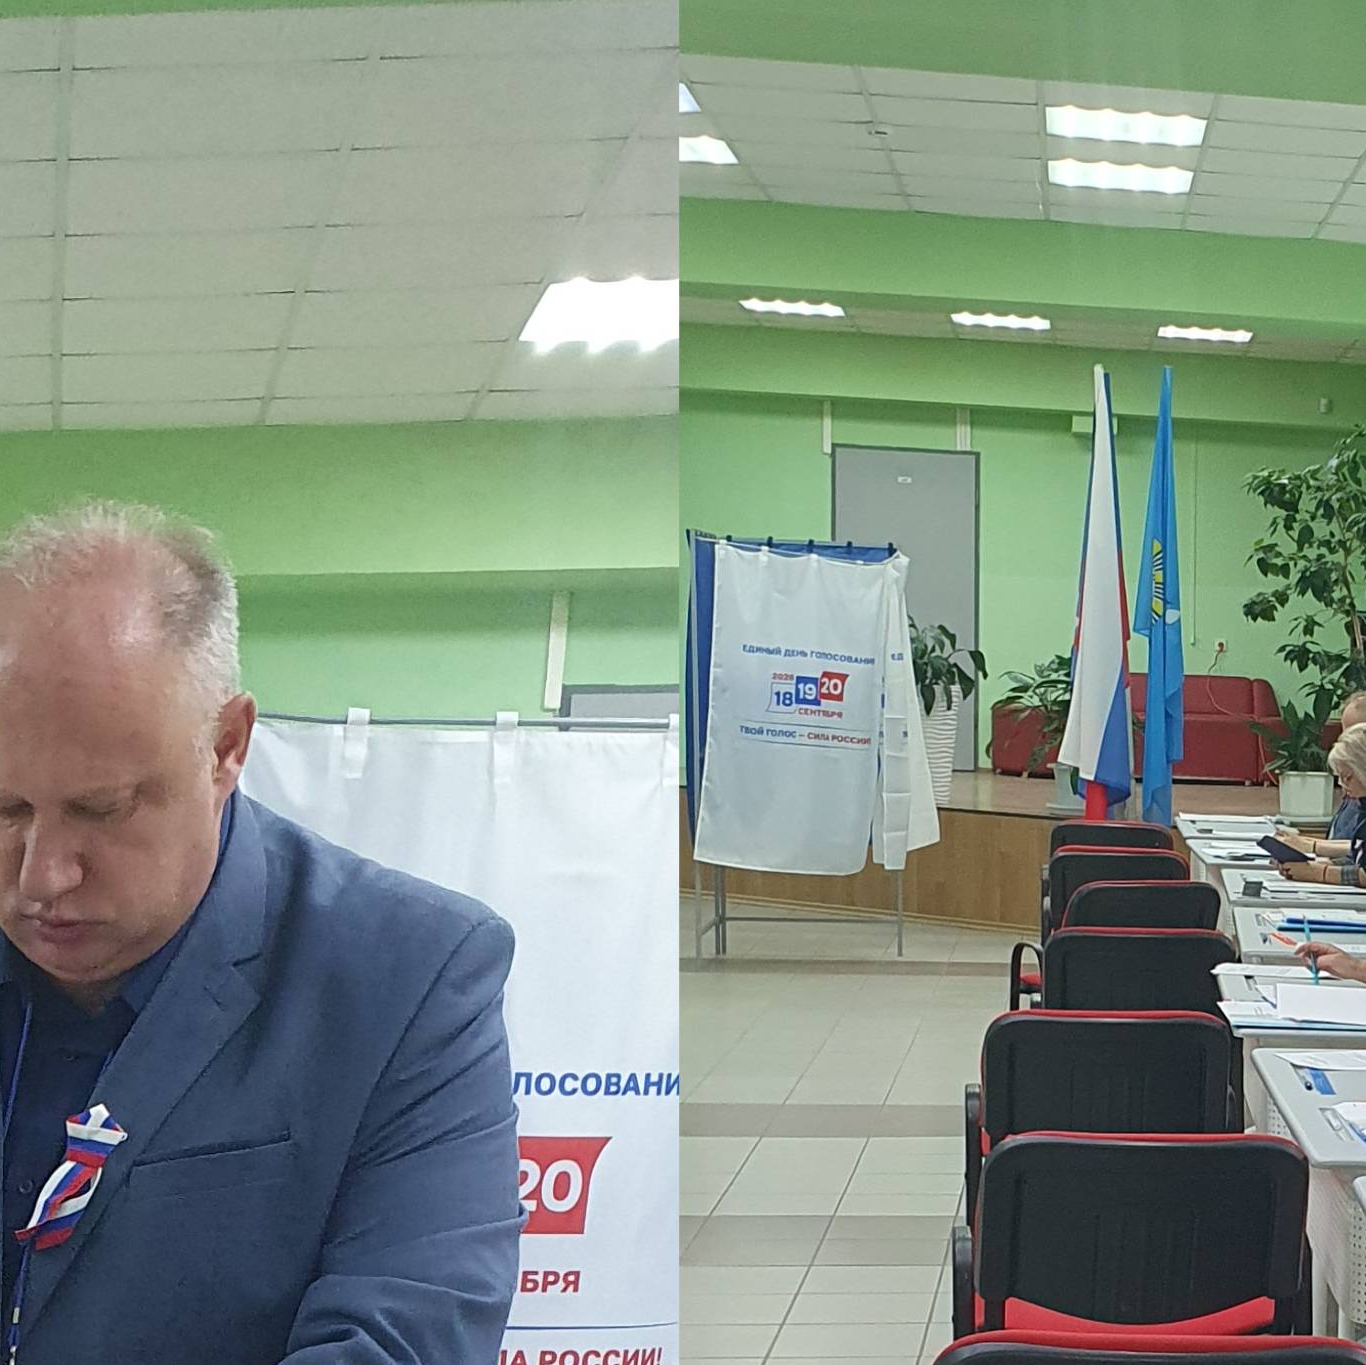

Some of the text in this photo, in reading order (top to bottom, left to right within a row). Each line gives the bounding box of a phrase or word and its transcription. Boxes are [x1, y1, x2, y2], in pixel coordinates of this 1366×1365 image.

[742, 644, 781, 656] ЕДИНЫЙ
[783, 649, 808, 659] ДЕНЬ
[798, 683, 816, 699] 19
[820, 678, 843, 694] 20
[774, 691, 793, 707] 18
[739, 725, 764, 736] ТВОЙ
[766, 728, 797, 739] ГОЛОС
[512, 1071, 679, 1097] ЛОСОВАНИ
[520, 1271, 581, 1293] БРЯ
